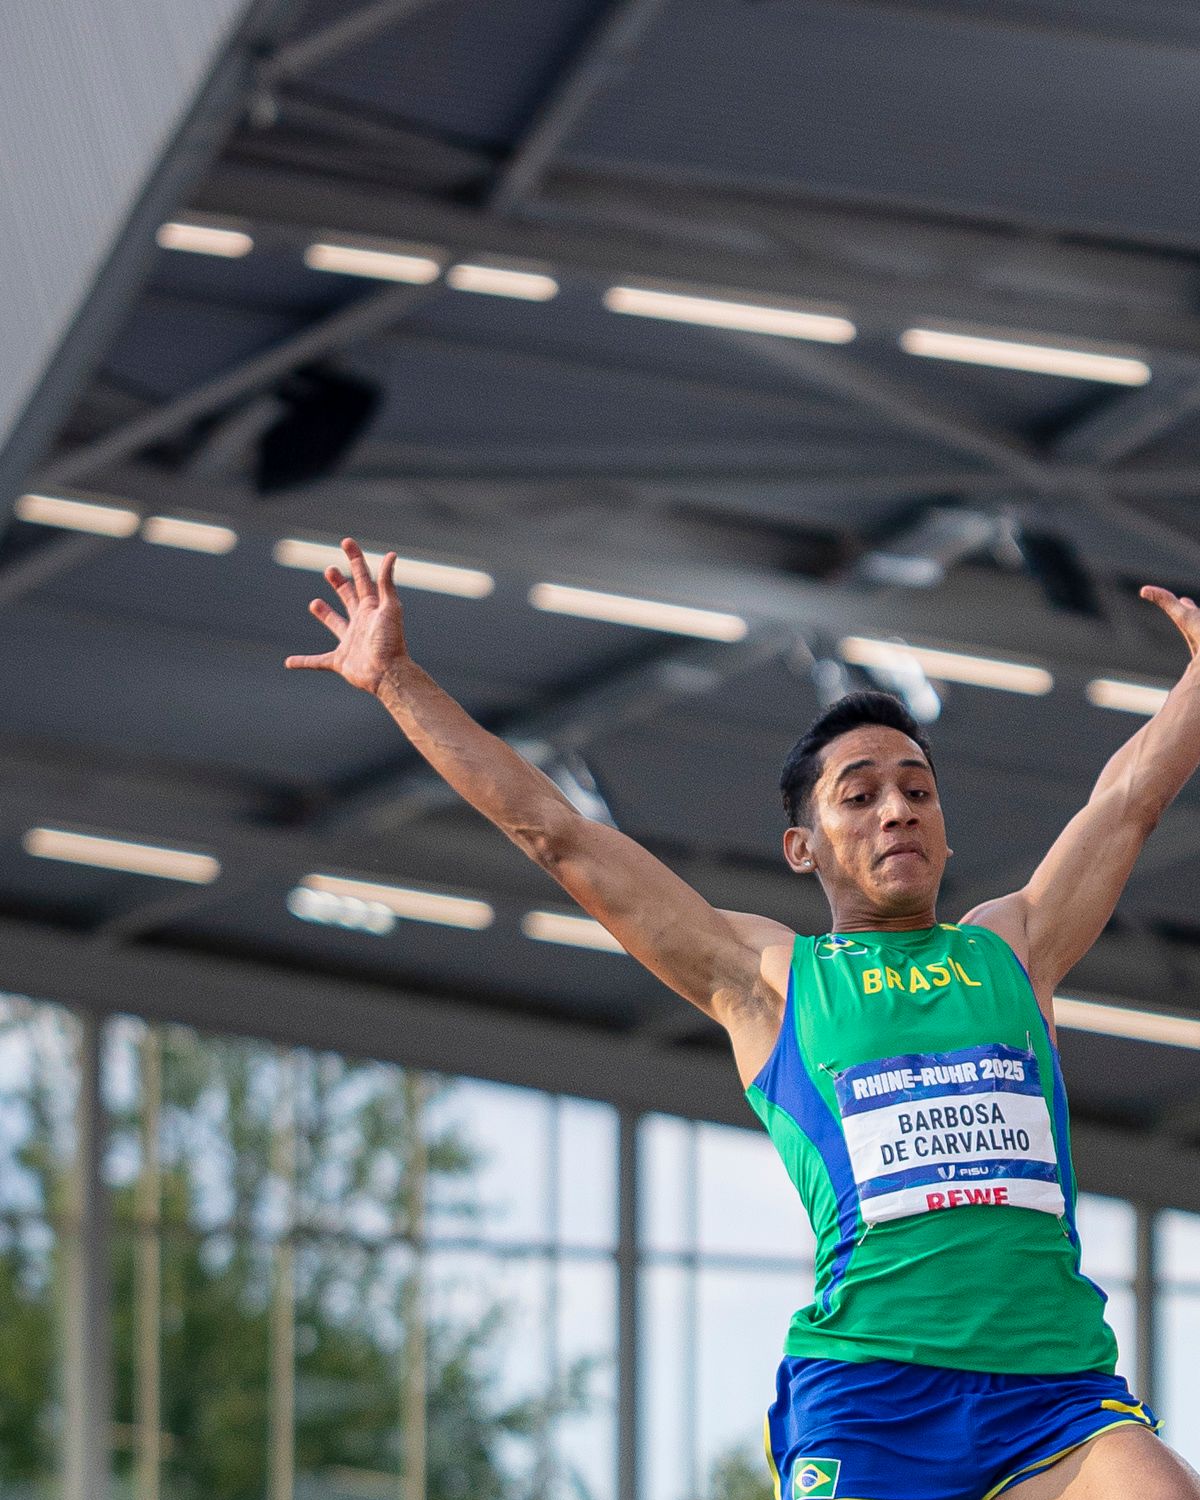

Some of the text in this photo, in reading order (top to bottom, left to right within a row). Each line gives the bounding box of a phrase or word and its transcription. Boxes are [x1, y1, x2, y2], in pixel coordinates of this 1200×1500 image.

[862, 956, 982, 995] BRASIL
[852, 1058, 1025, 1100] RHINE-RUHR 2025
[898, 1102, 1006, 1134] BARBOSA
[880, 1128, 1030, 1165] DE CARVALHO
[960, 1166, 990, 1177] FISU
